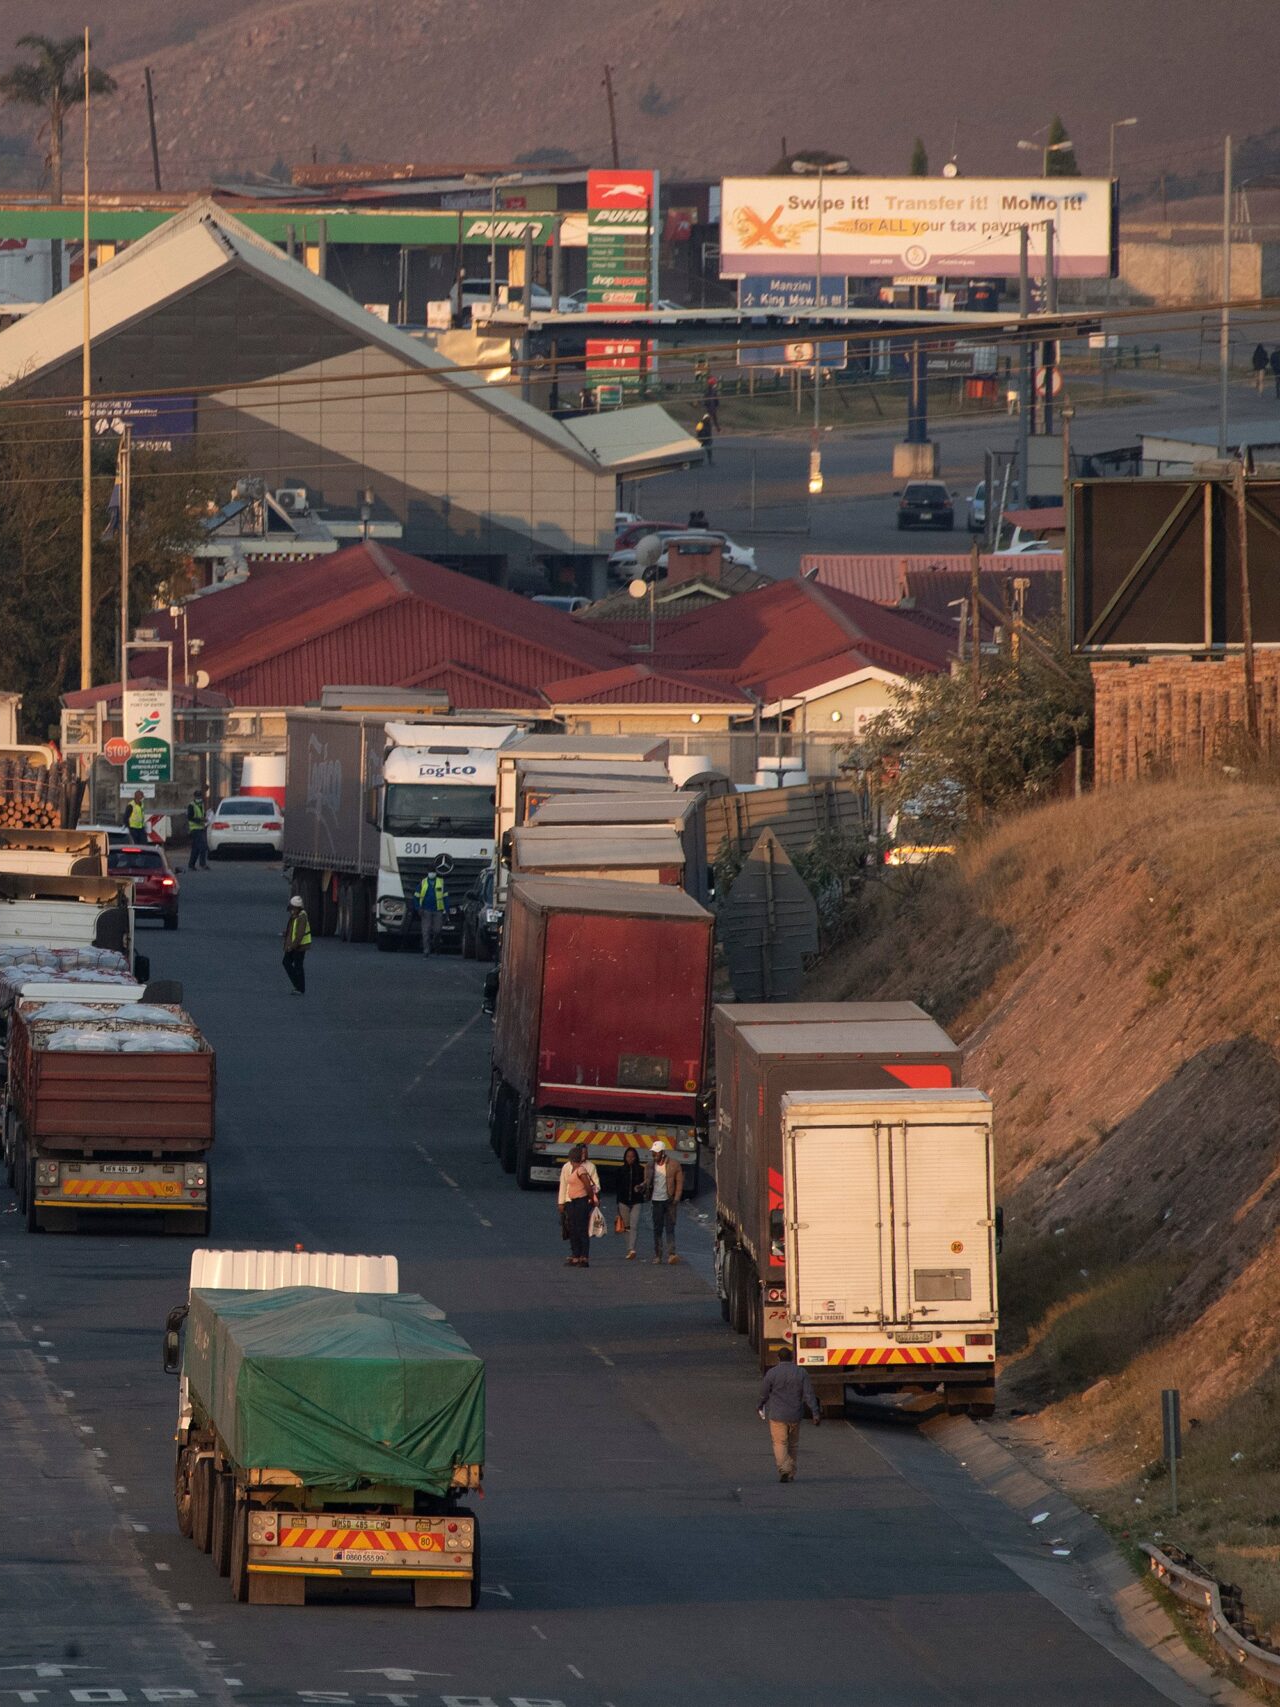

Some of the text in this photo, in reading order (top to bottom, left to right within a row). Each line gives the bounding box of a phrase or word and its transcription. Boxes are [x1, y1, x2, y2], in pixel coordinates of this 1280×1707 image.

[788, 195, 1083, 213] Swipe it! Transfer it! MoMo it!
[594, 209, 648, 223] PUMA
[878, 220, 908, 232] ALL
[912, 221, 945, 235] your
[950, 220, 977, 232] tax
[771, 280, 811, 291] Manzini
[760, 294, 785, 307] King
[789, 294, 828, 307] Mswti
[107, 746, 129, 757] STOP
[420, 766, 476, 777] Logico
[405, 842, 428, 854] 801
[420, 1538, 430, 1546] 80
